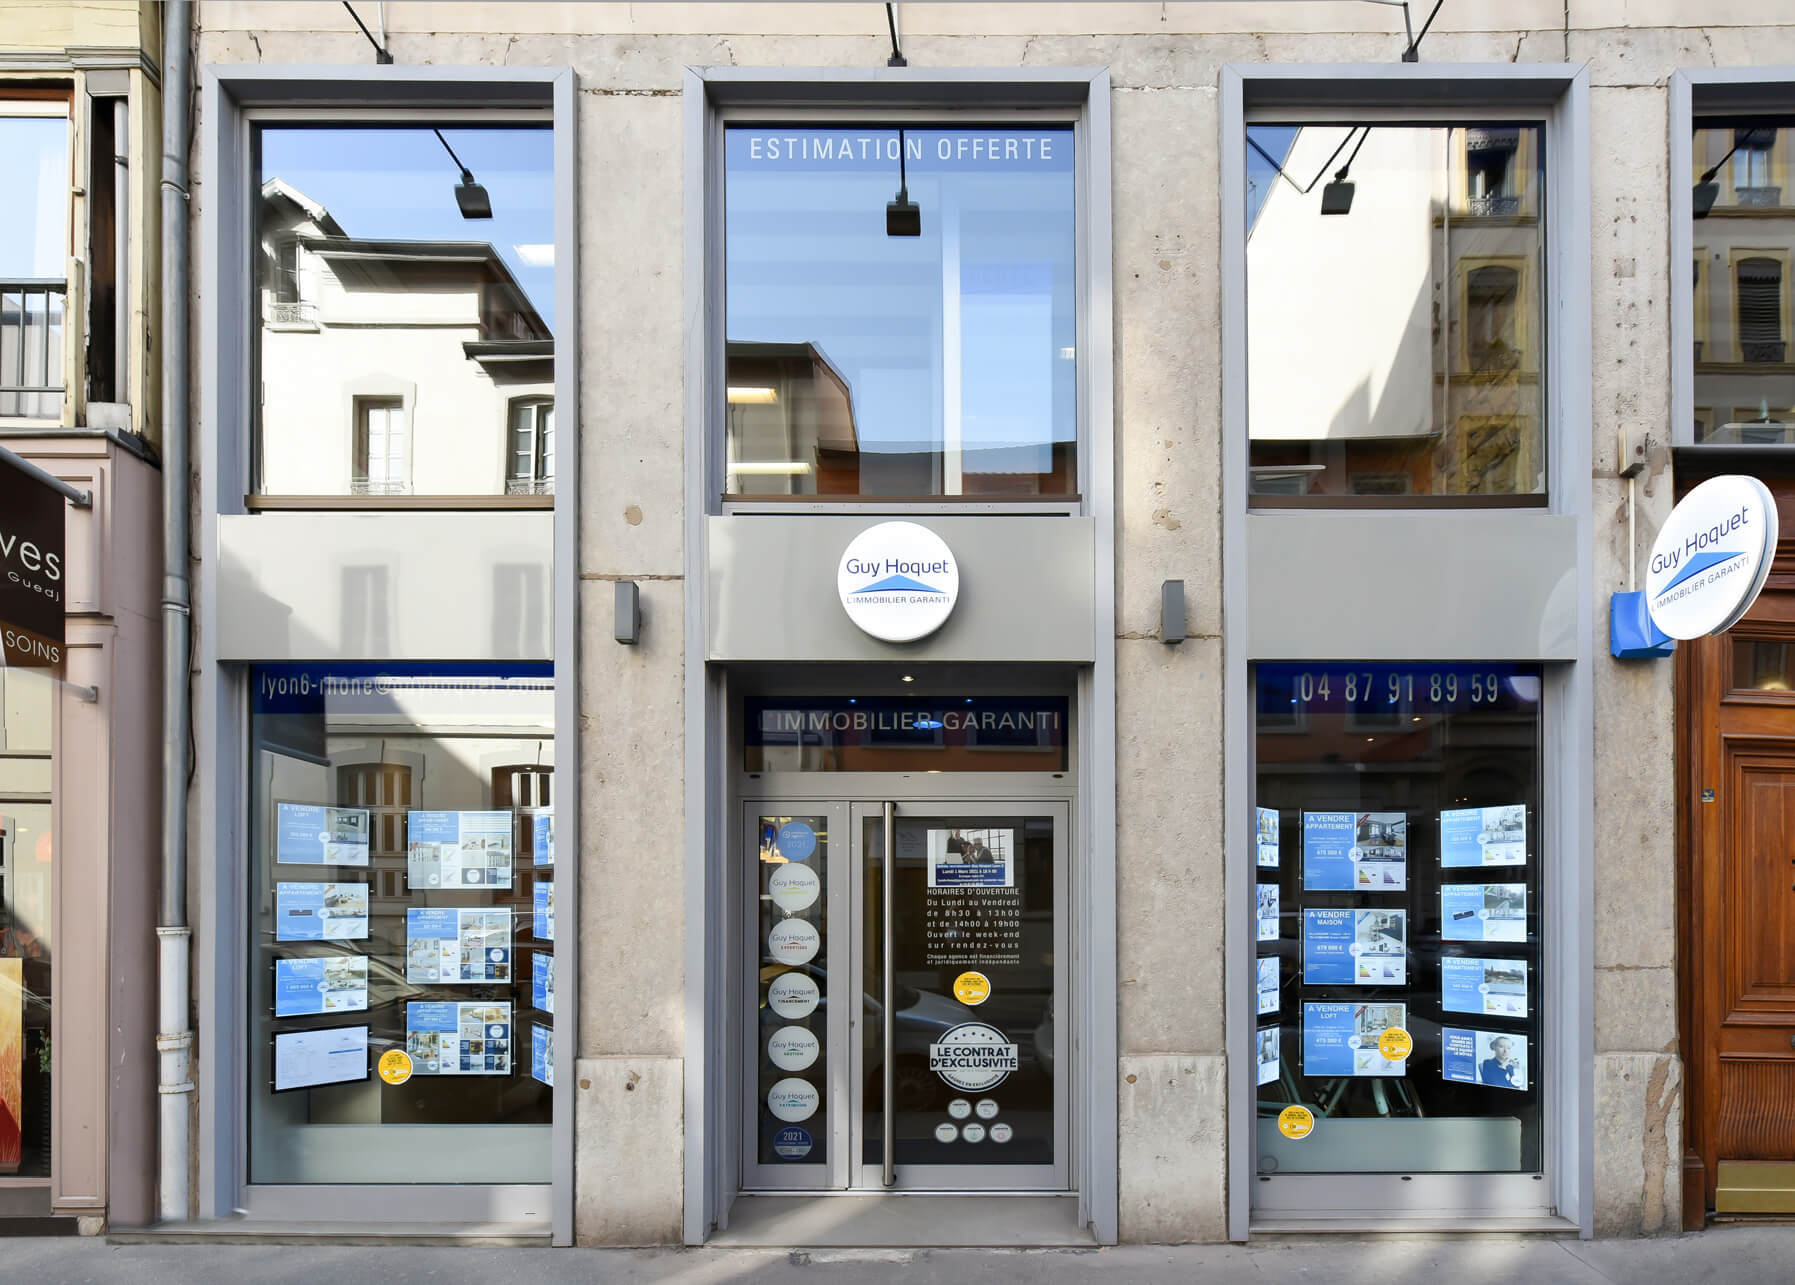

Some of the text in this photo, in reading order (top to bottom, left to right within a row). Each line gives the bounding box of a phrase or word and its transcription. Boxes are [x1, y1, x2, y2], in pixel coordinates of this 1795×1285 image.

[751, 137, 1053, 160] ESTIMATION OFFERTE
[1651, 505, 1749, 574] Guy Hoquet
[846, 558, 949, 577] Guy Hoquet
[8, 571, 60, 602] Guedj
[1651, 556, 1749, 611] L'IMMOBILIER GARANTI
[847, 596, 949, 604] L'IMMOBILIER GARANTI
[5, 630, 60, 664] SOINS
[1300, 672, 1498, 702] 04 87 91 89 59
[942, 711, 1059, 730] GARANTI
[773, 934, 787, 942] Guy
[1316, 1005, 1350, 1013] VENDRE
[938, 1048, 1010, 1056] LE CONTRAT
[931, 1057, 1016, 1068] D'EXCLUSIVITÉ
[772, 1092, 786, 1100] Guy
[784, 1132, 803, 1141] 2021
